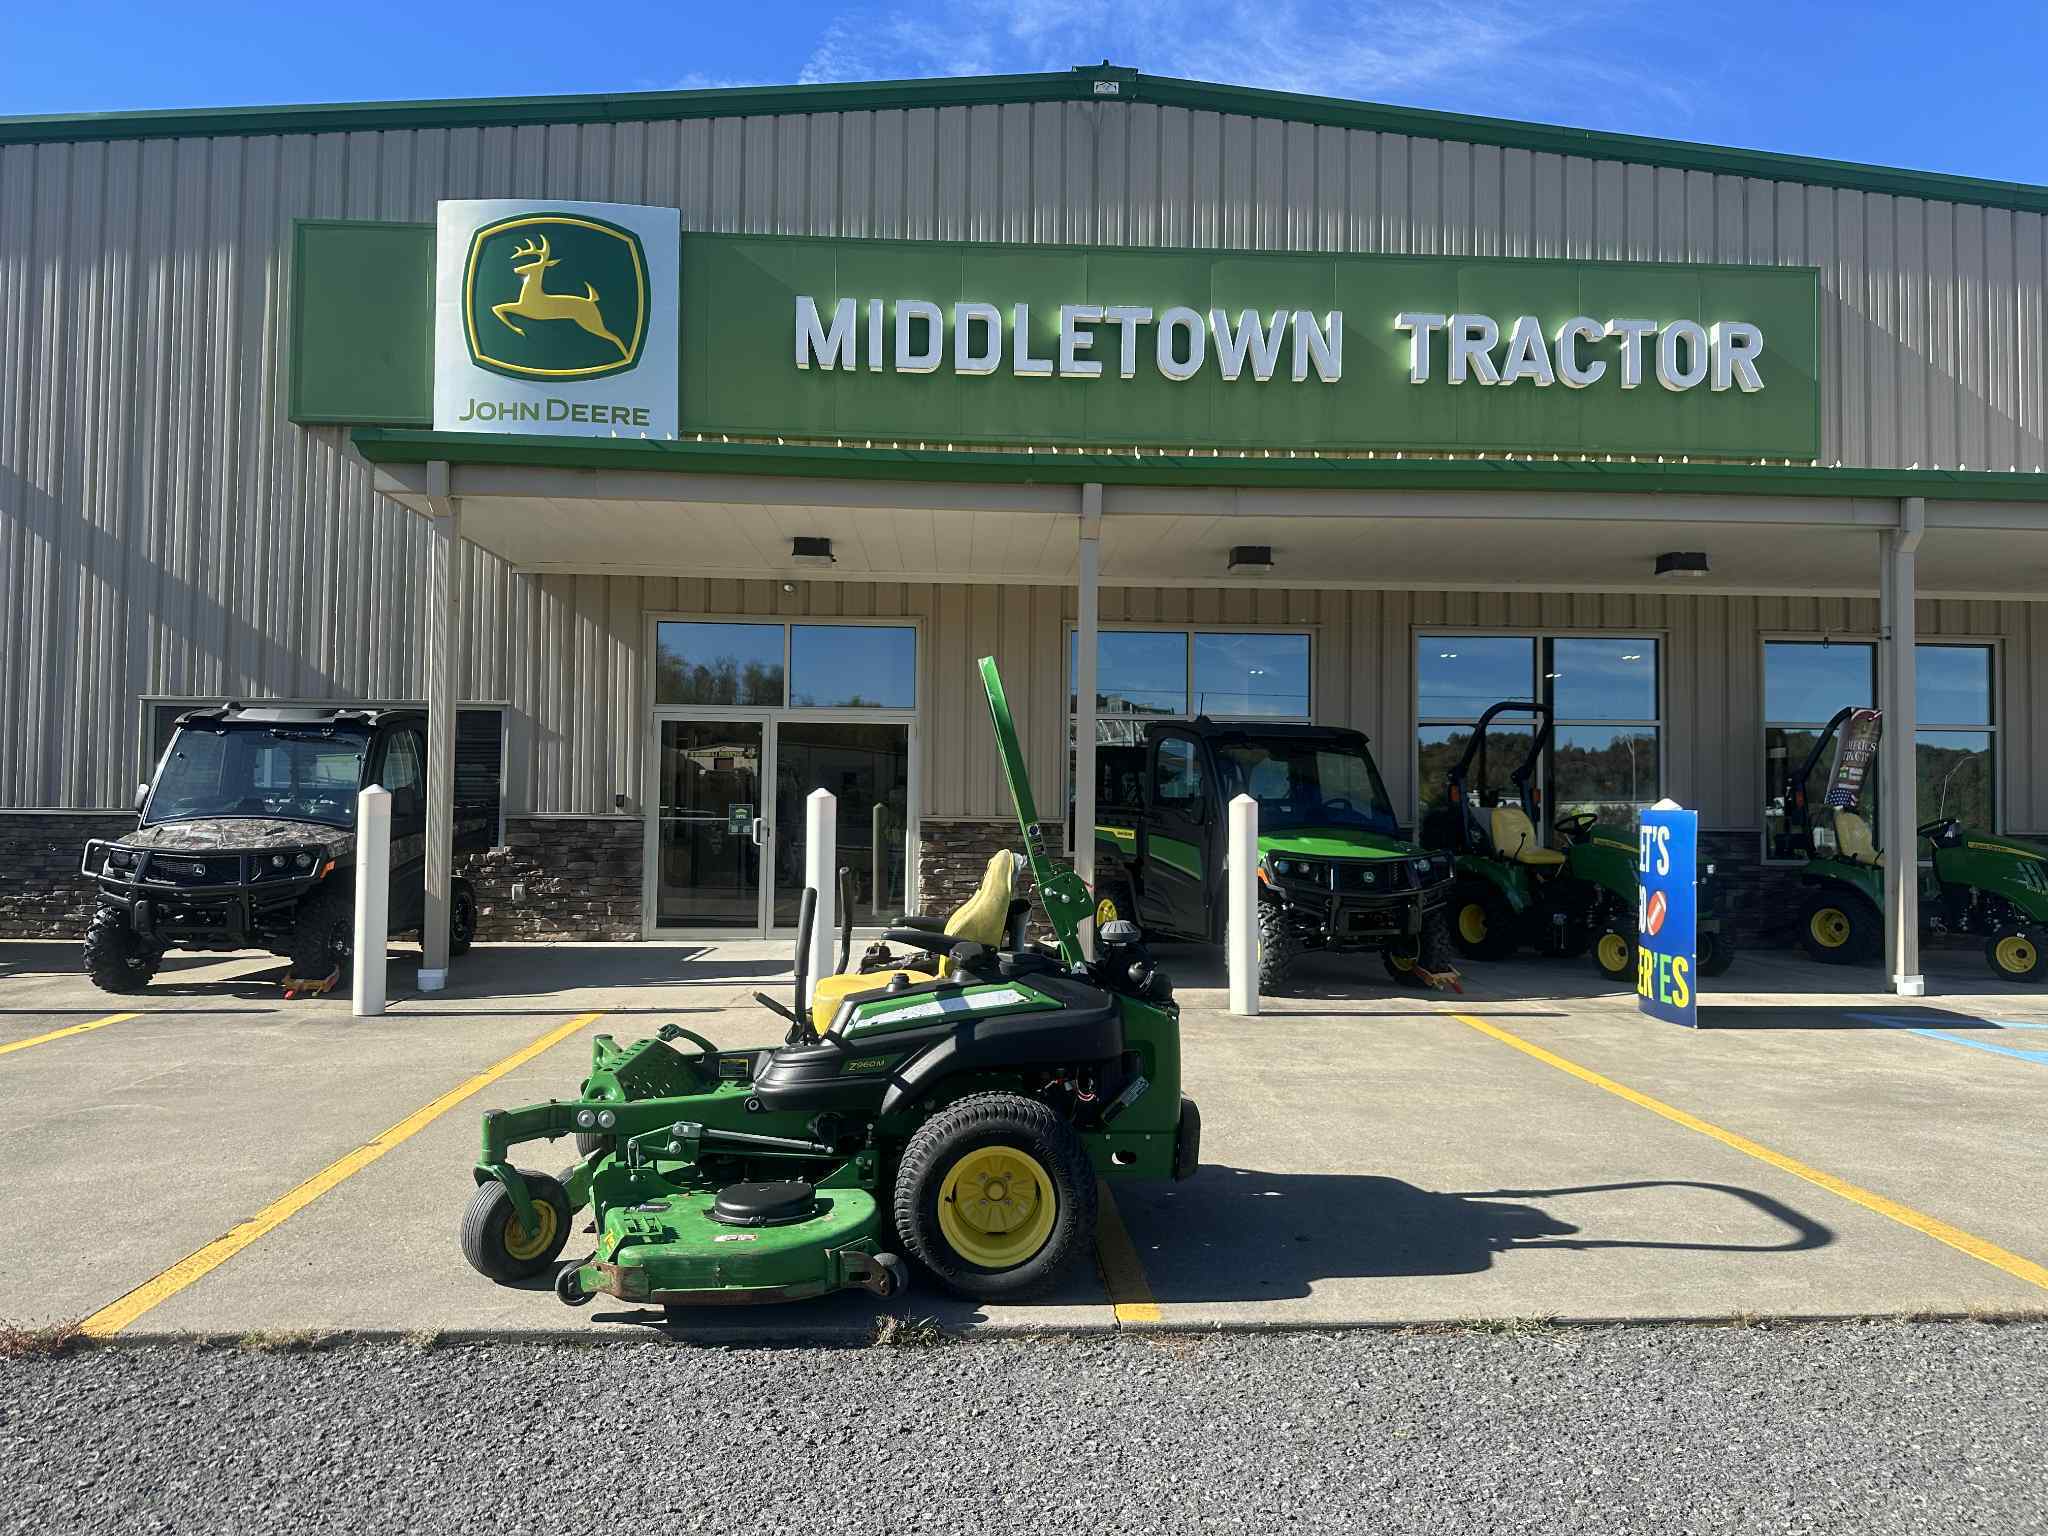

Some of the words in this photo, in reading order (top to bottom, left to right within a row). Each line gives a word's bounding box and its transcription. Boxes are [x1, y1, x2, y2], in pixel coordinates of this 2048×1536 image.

[795, 296, 1342, 383] MIDDLETOWN
[1395, 312, 1764, 393] TRACTOR
[459, 398, 540, 422] JOHN
[546, 398, 650, 427] DEERE
